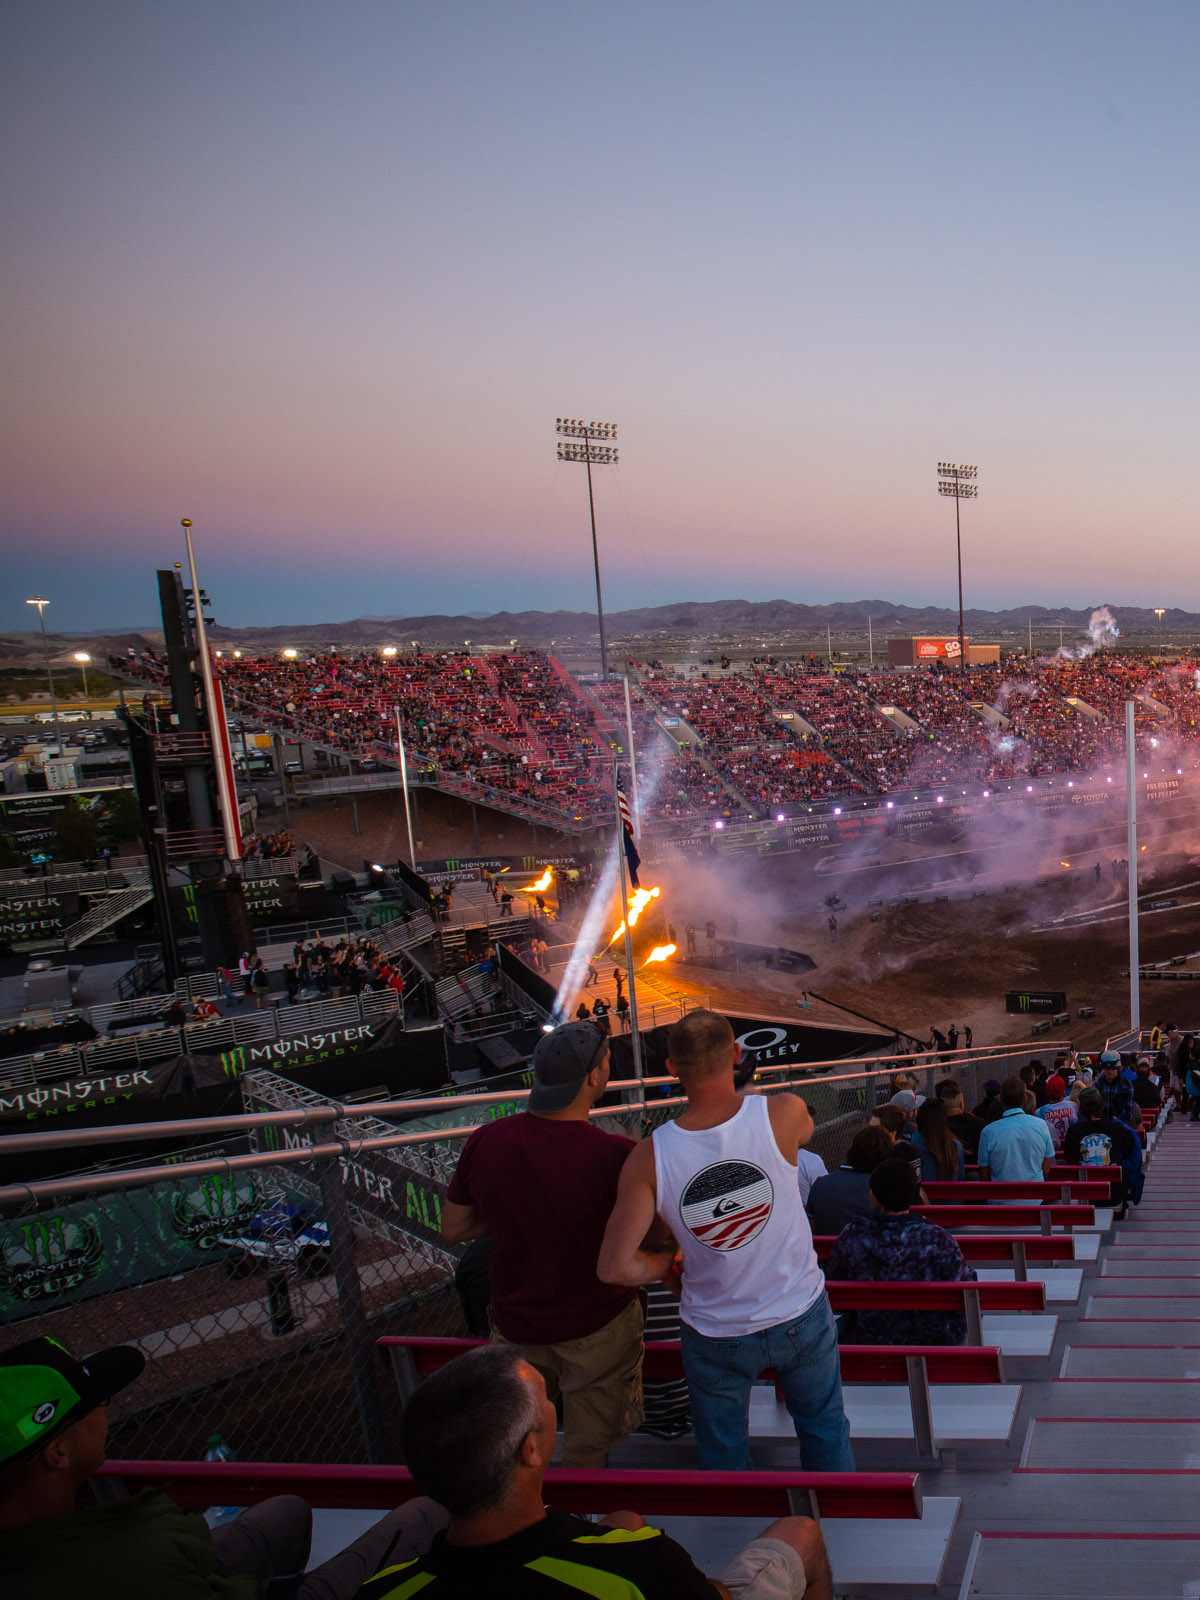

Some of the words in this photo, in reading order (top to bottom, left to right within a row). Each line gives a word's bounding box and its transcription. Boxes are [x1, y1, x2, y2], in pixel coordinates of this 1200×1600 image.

[945, 641, 961, 652] GO
[1082, 793, 1109, 802] TOYOTA
[793, 823, 829, 833] MONSTER
[661, 838, 703, 849] MONSTER
[795, 834, 830, 844] MONSTER
[460, 861, 502, 870] MONSTER
[535, 857, 576, 866] MONSTER
[240, 878, 281, 892] STER
[427, 873, 476, 884] MONSTER
[0, 897, 60, 912] NSTER
[0, 918, 64, 934] NSTER
[250, 1024, 376, 1061] MONSTER
[272, 1044, 360, 1069] ENERGY
[756, 1043, 800, 1060] KLEY
[0, 1069, 155, 1112] MONSTER
[26, 1092, 134, 1120] ENERGY
[22, 1273, 85, 1299] CUP
